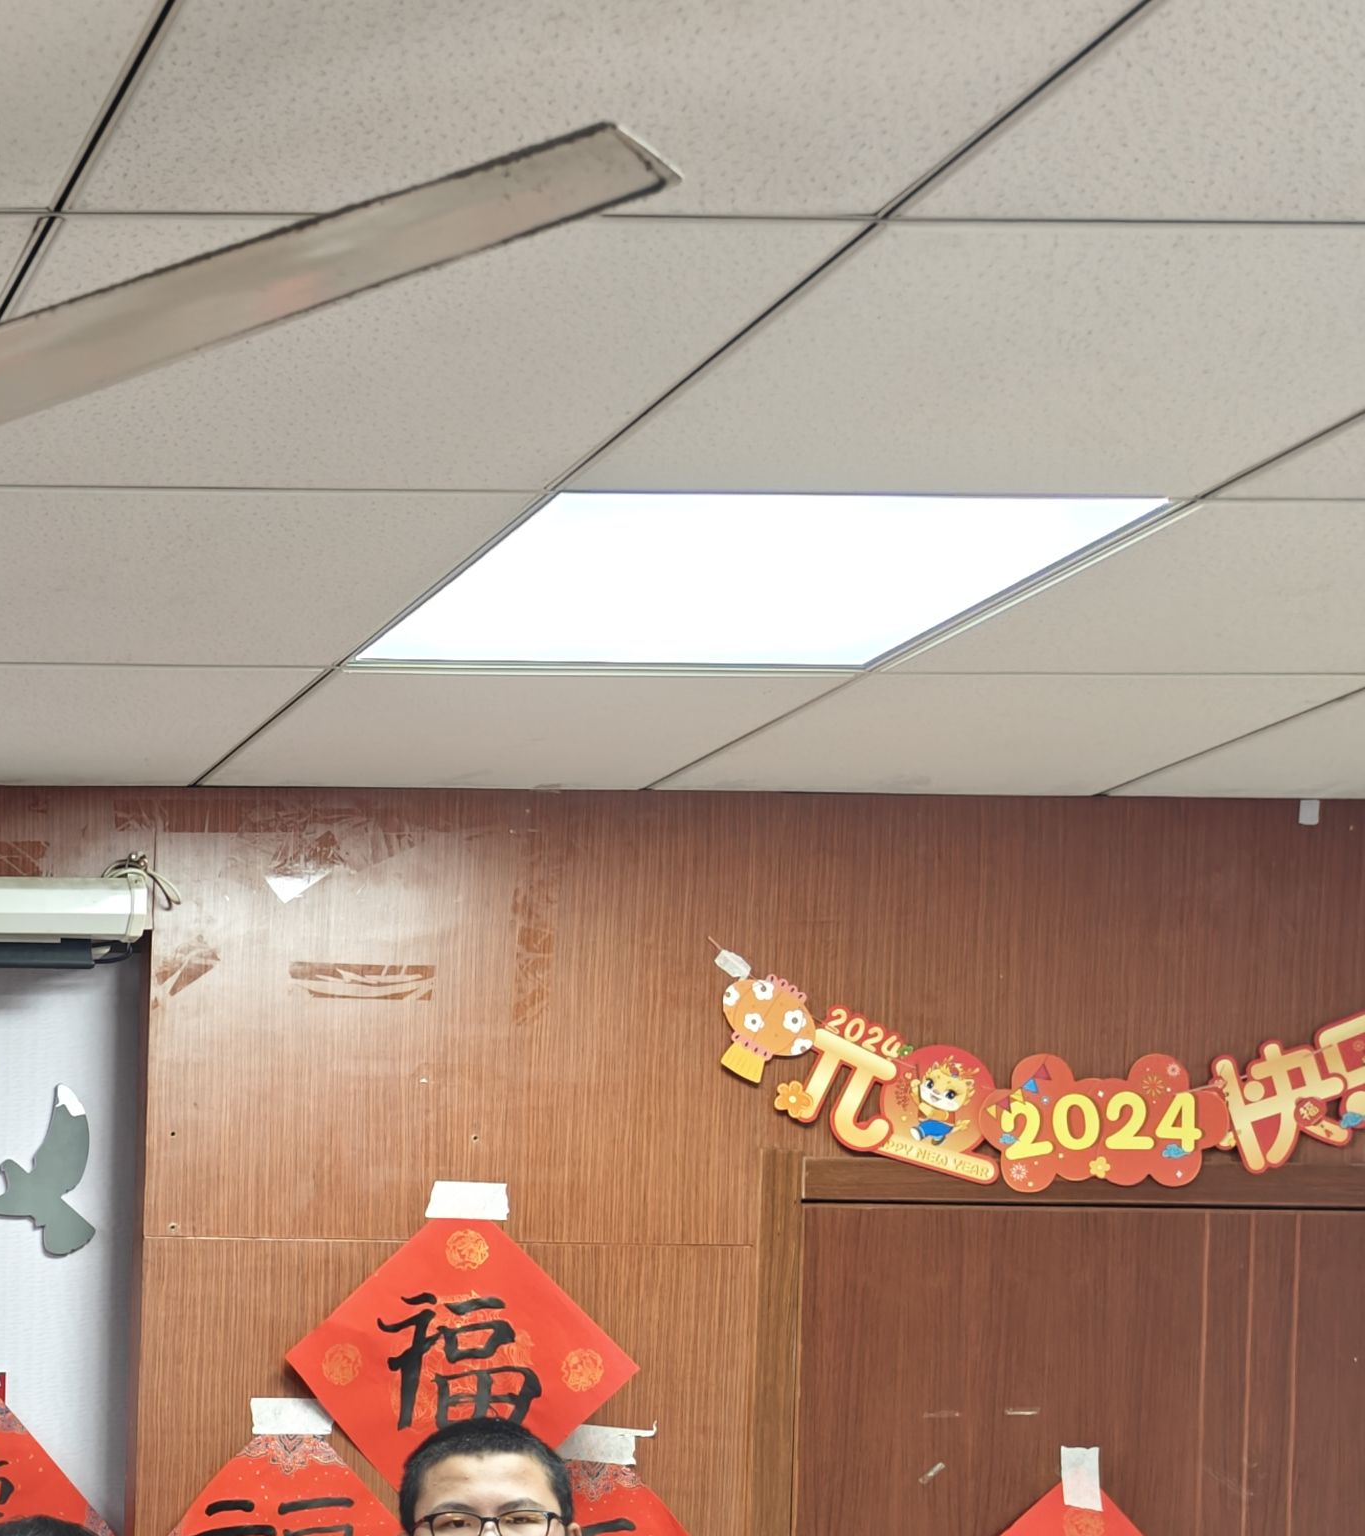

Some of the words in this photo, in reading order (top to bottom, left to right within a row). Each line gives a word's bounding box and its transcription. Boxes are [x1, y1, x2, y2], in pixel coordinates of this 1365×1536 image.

[825, 1006, 903, 1059] 2024
[1002, 1091, 1202, 1160] 2024
[379, 1294, 540, 1432] 福
